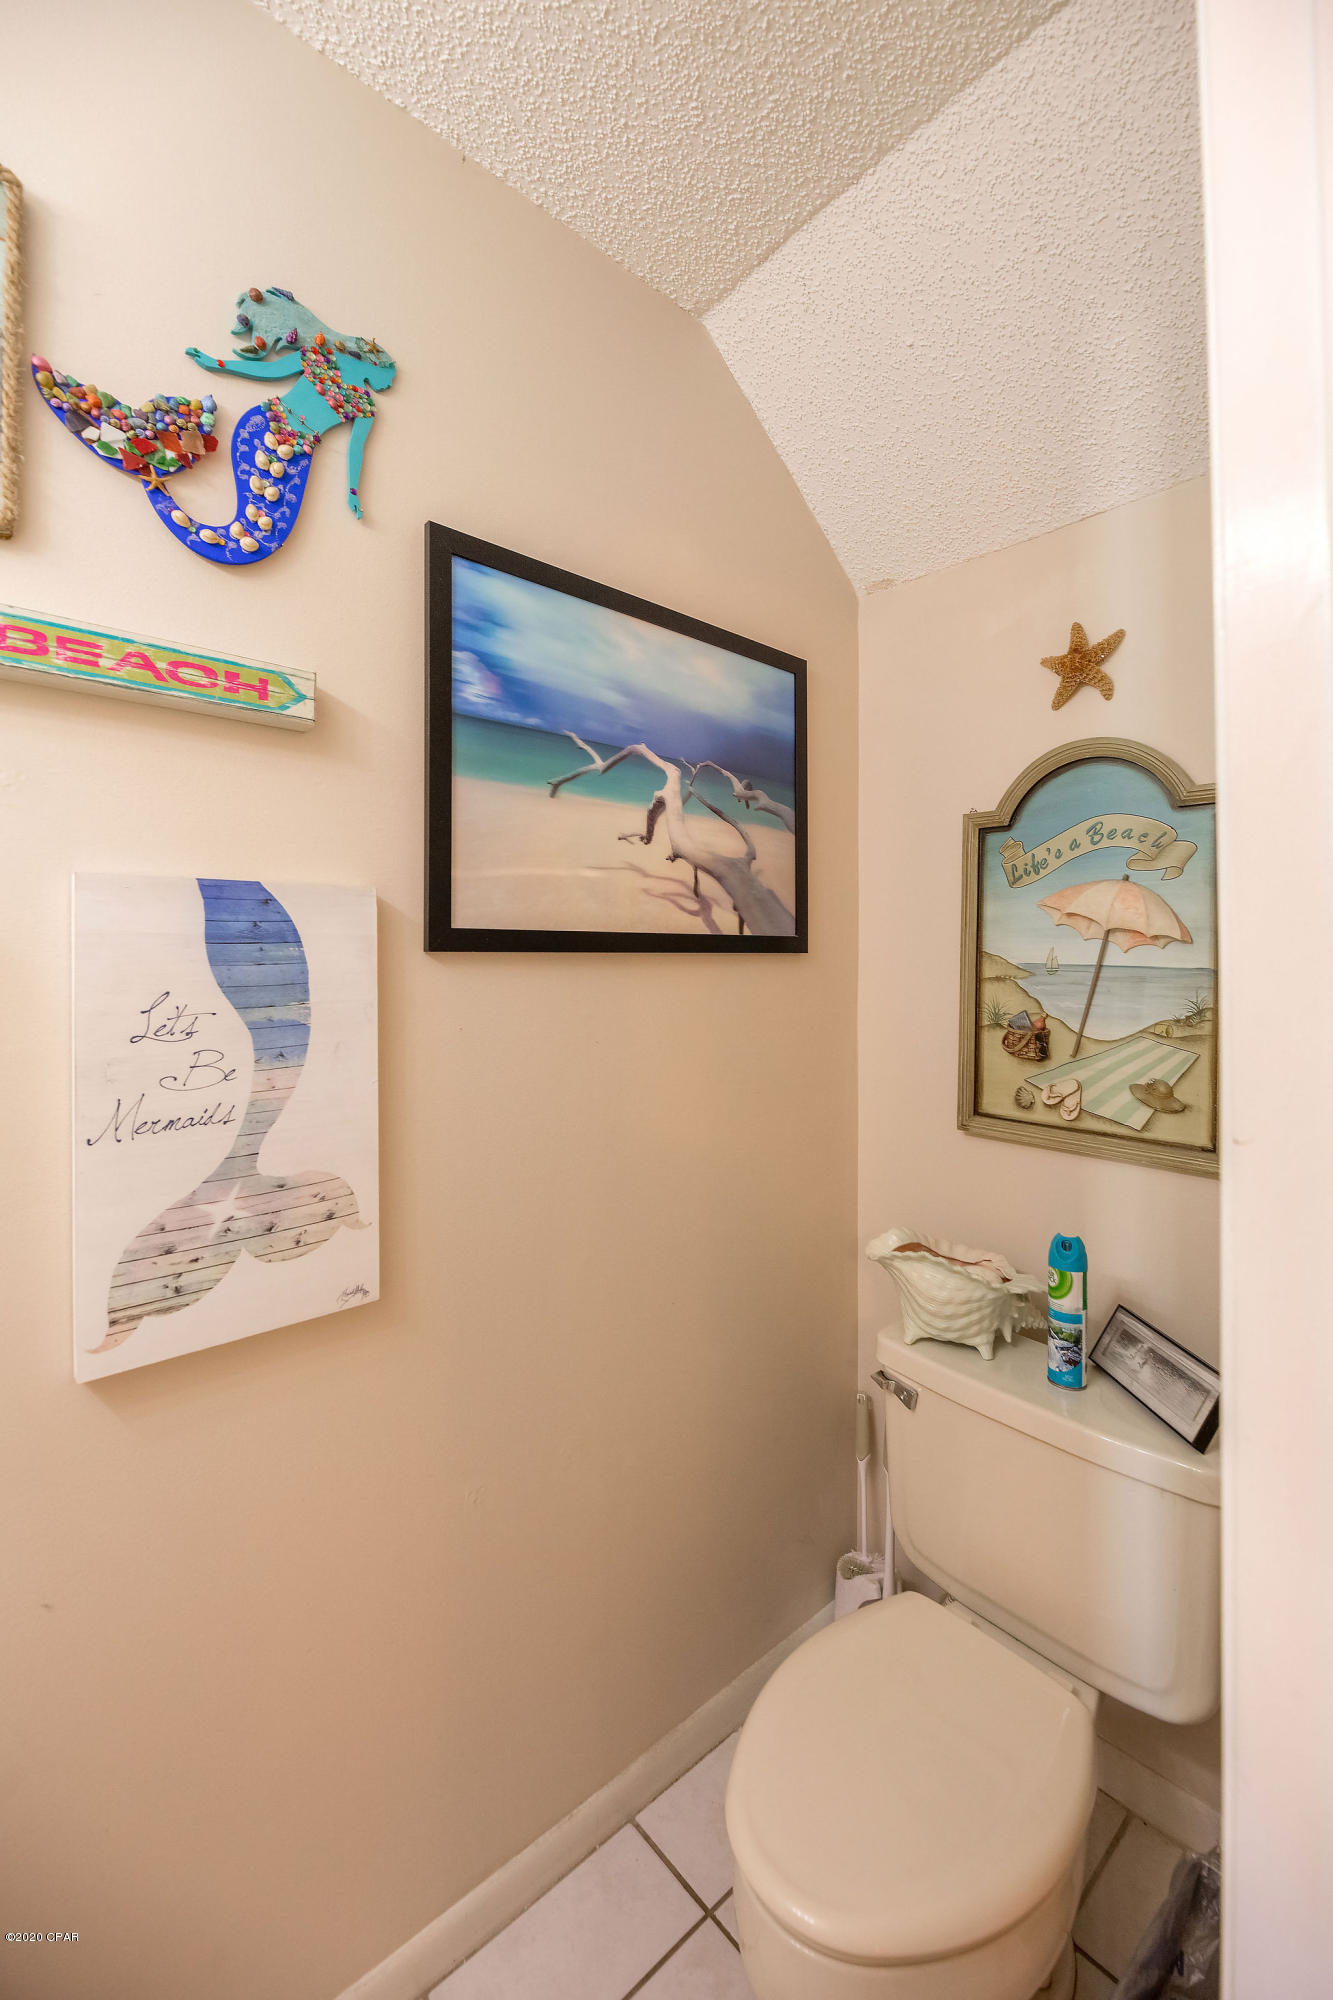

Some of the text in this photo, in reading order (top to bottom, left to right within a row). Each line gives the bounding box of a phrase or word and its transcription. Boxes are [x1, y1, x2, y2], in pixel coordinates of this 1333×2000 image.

[0, 623, 269, 701] BEACH
[1011, 821, 1168, 885] Life's a Beach
[159, 1049, 238, 1091] Be
[87, 1093, 236, 1146] Mermaids
